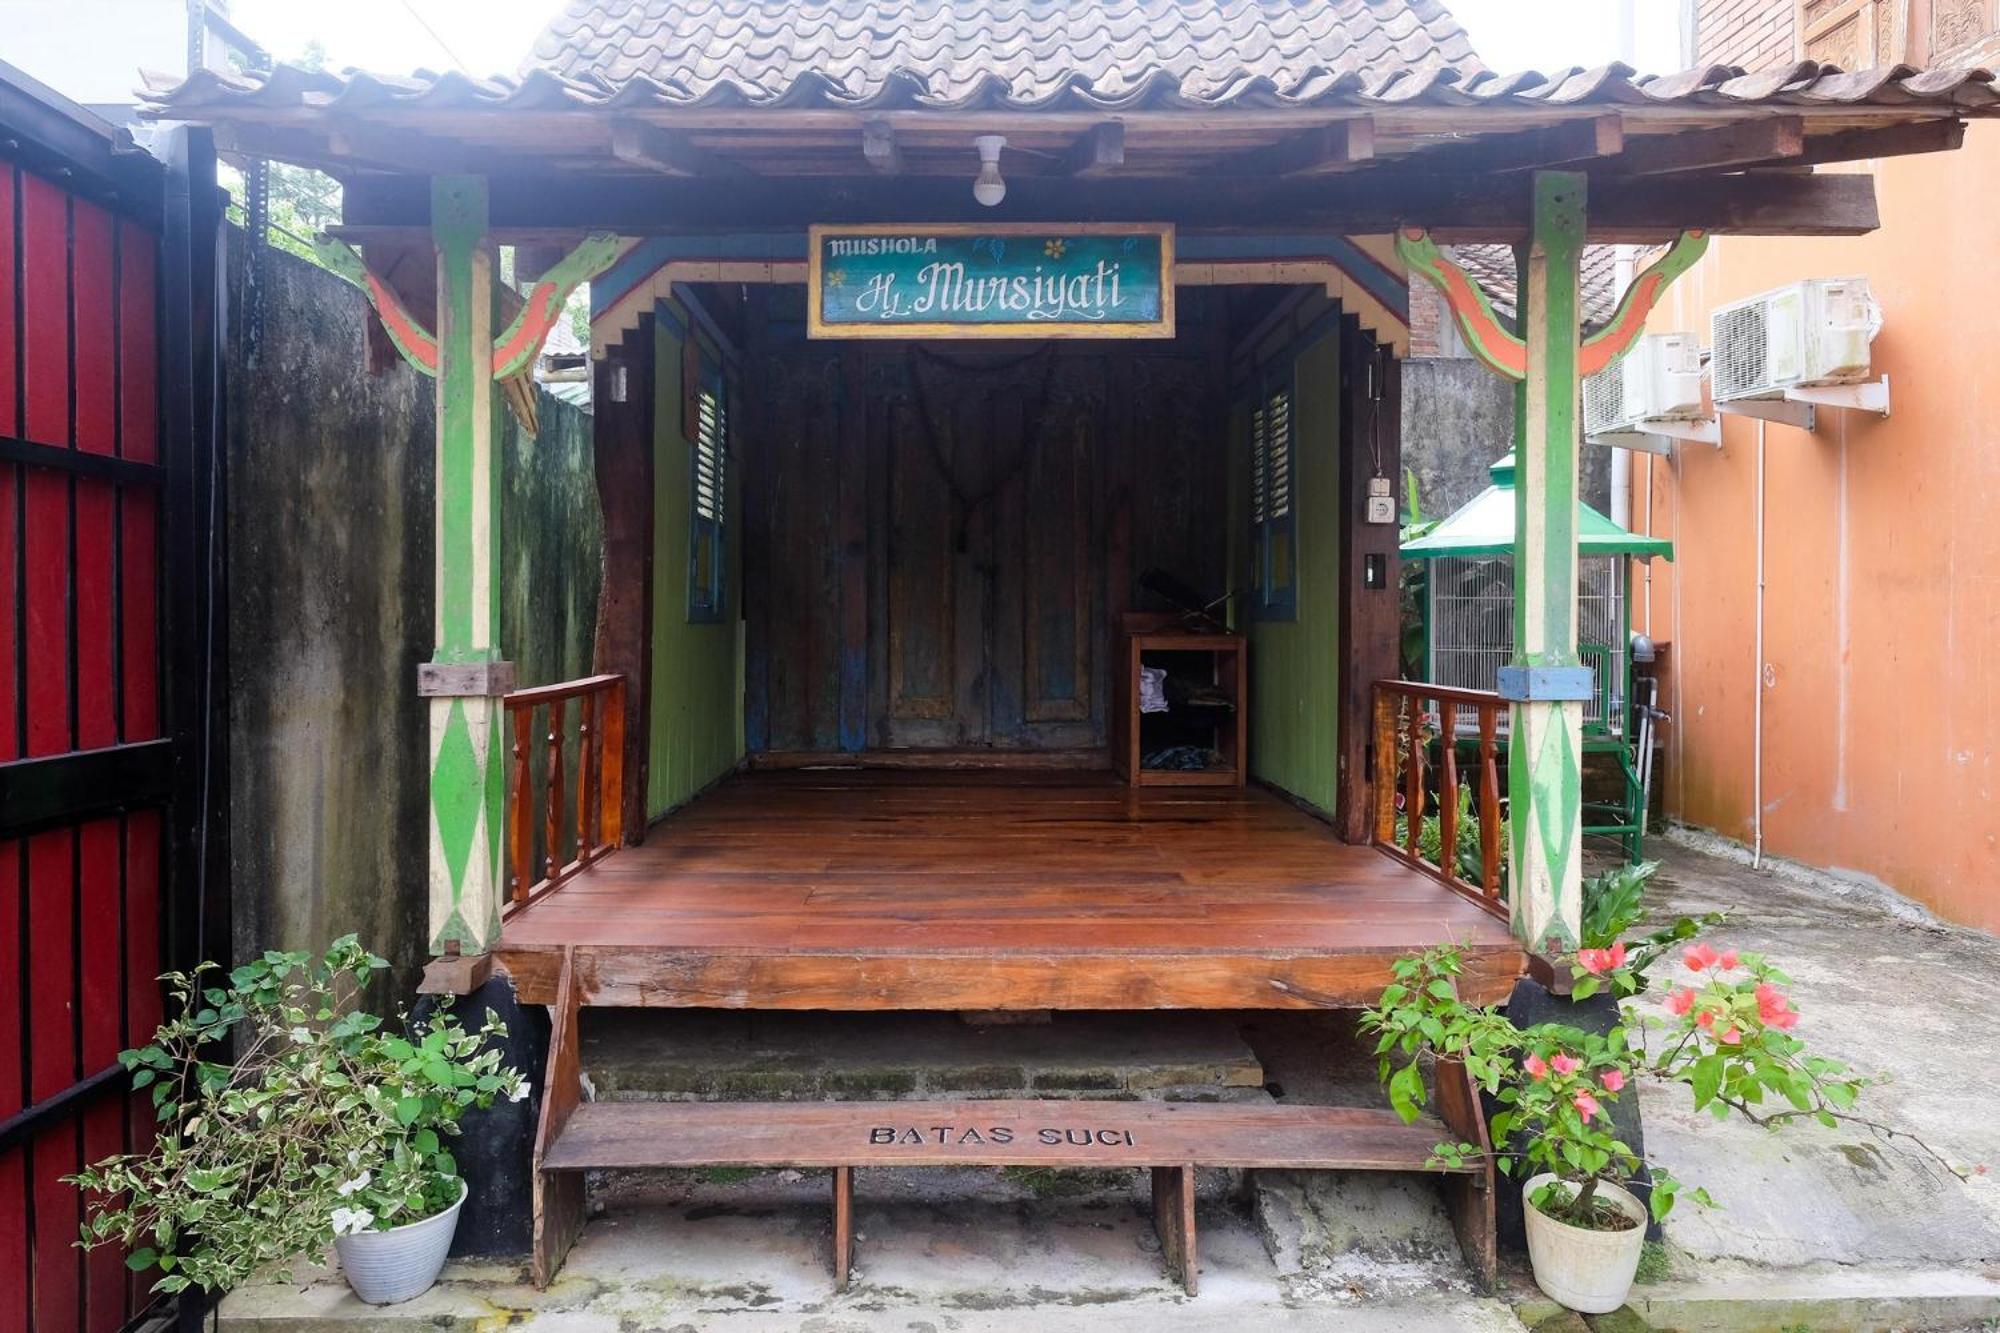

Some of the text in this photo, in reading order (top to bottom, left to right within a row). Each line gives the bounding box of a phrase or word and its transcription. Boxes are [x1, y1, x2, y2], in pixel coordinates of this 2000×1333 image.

[827, 238, 937, 257] MUSHOLA
[914, 260, 1125, 320] Mursiyati
[869, 1127, 1134, 1146] BATAS SUCI
